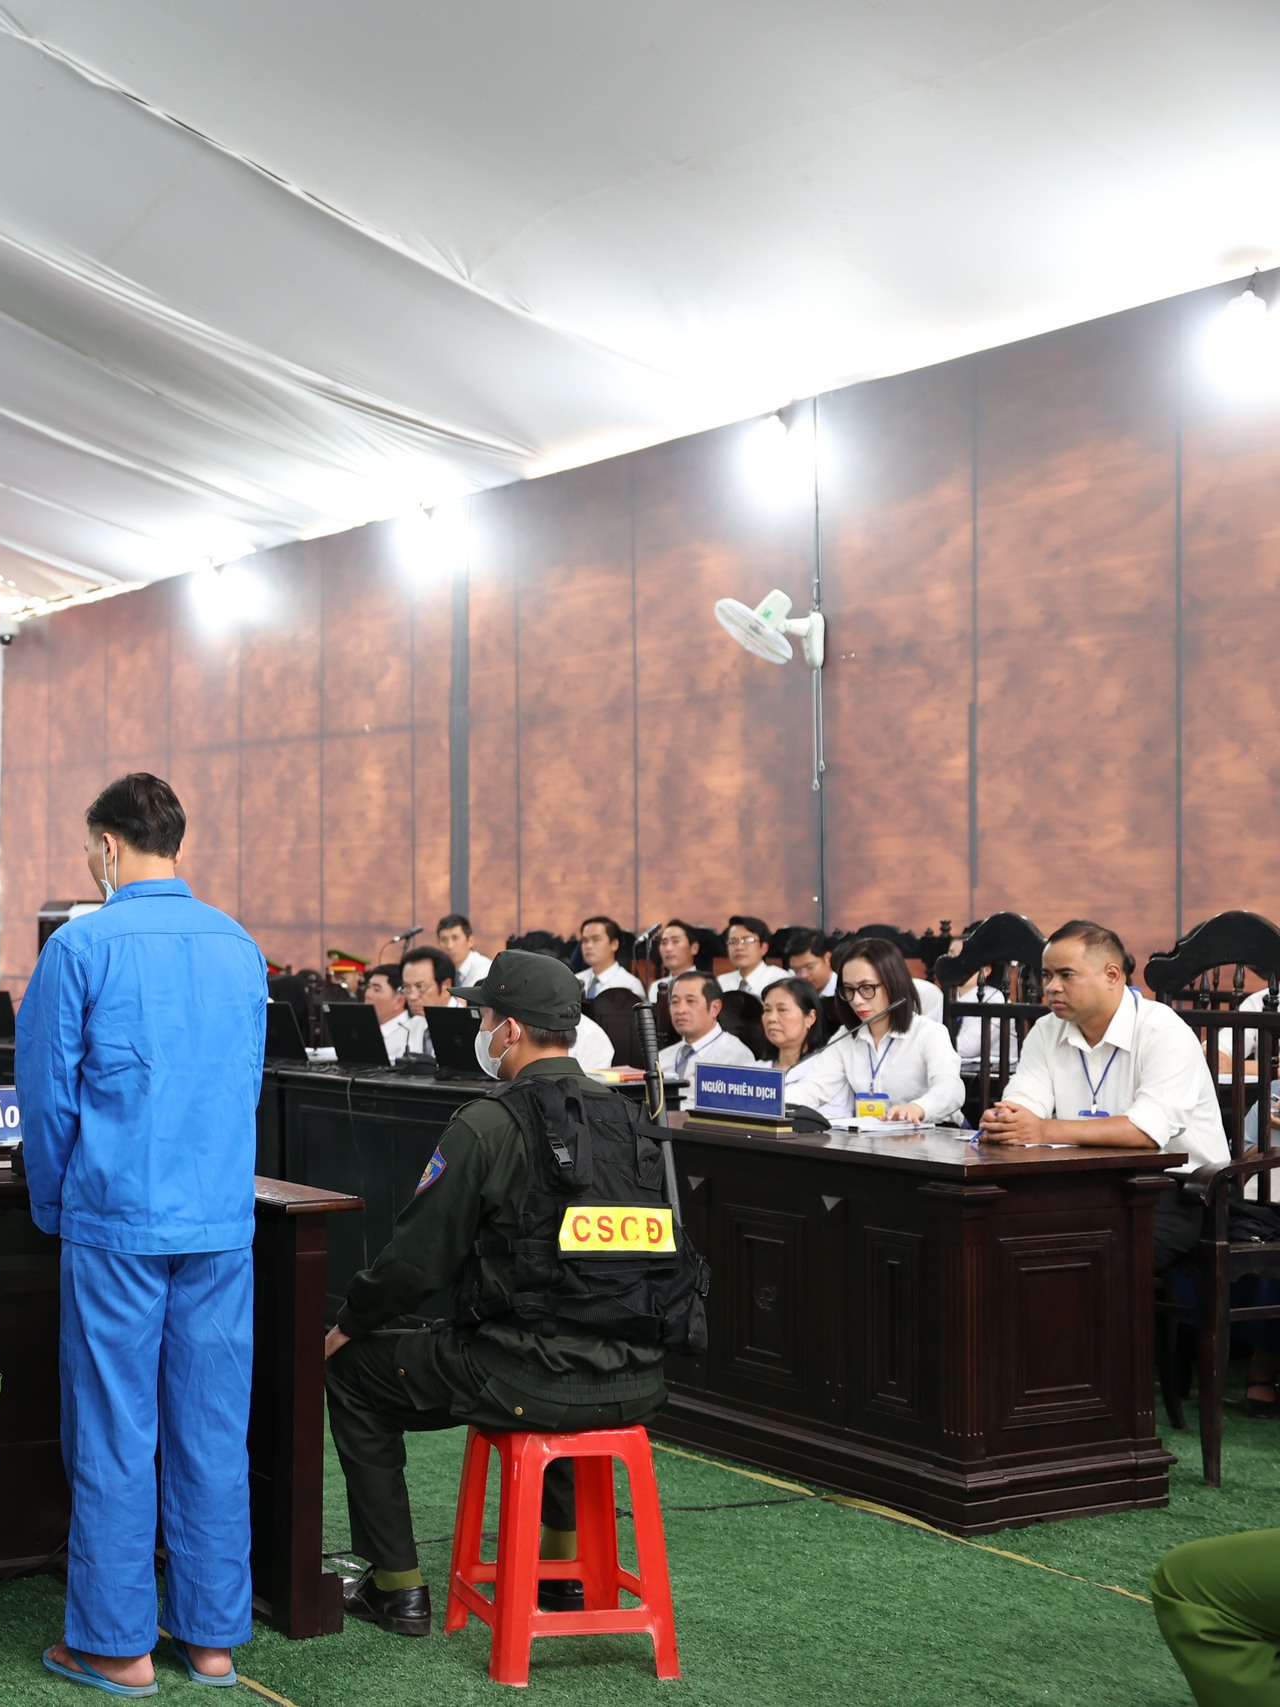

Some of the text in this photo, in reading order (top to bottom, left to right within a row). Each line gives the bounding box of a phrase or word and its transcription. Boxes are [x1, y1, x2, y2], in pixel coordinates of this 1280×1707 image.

[701, 1079, 776, 1100] NGƯỜI PHIÊN DỊCH
[572, 1215, 663, 1243] CSCĐ
